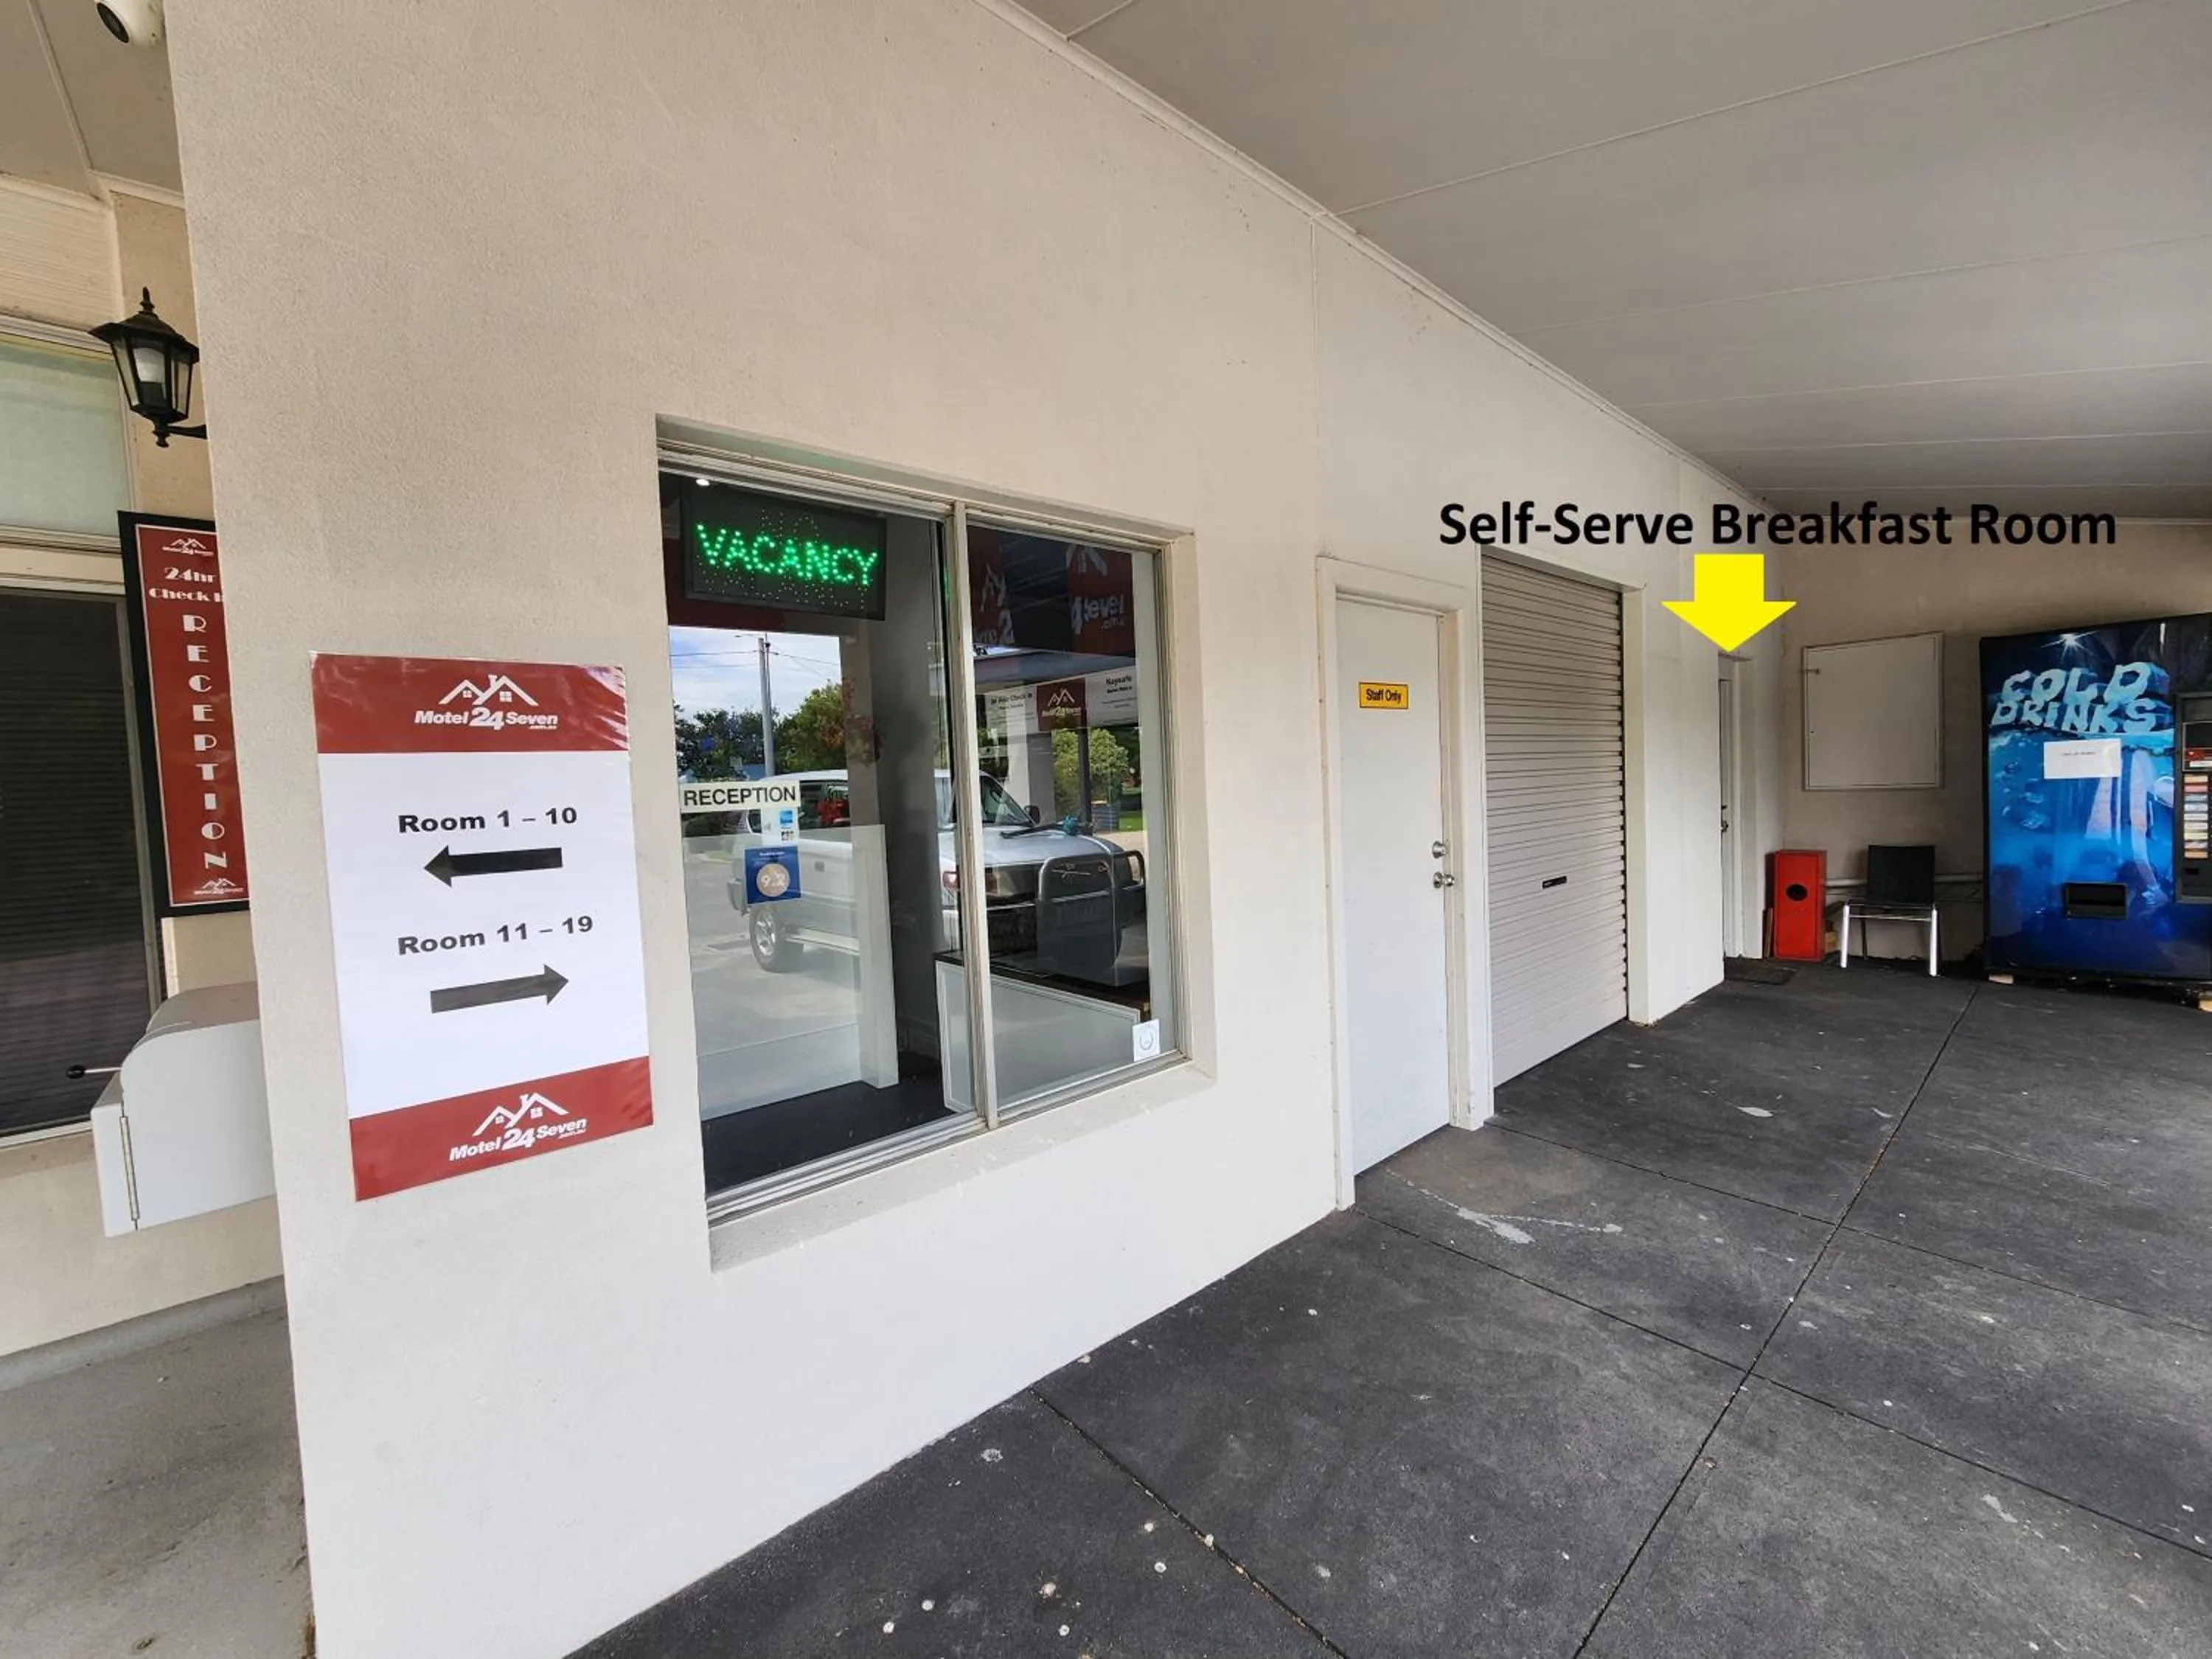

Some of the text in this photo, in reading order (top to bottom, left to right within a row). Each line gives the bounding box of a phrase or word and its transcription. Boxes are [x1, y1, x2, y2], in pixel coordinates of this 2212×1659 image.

[695, 522, 878, 585] VACANCY
[164, 566, 218, 583] 24hr
[148, 588, 212, 602] Check
[1366, 687, 1401, 704] Staff Only
[2000, 661, 2153, 703] COLD
[414, 706, 558, 730] Motel 24 Seven
[1992, 698, 2158, 733] DRINKS
[182, 614, 228, 870] RECEPTION
[684, 785, 796, 806] RECEPTION
[398, 814, 486, 833] Room
[496, 810, 509, 827] 1
[545, 807, 577, 824] 10
[397, 932, 485, 956] Room
[496, 922, 527, 942] 11
[562, 915, 593, 934] 19
[449, 1118, 587, 1161] Motel 24 Seven
